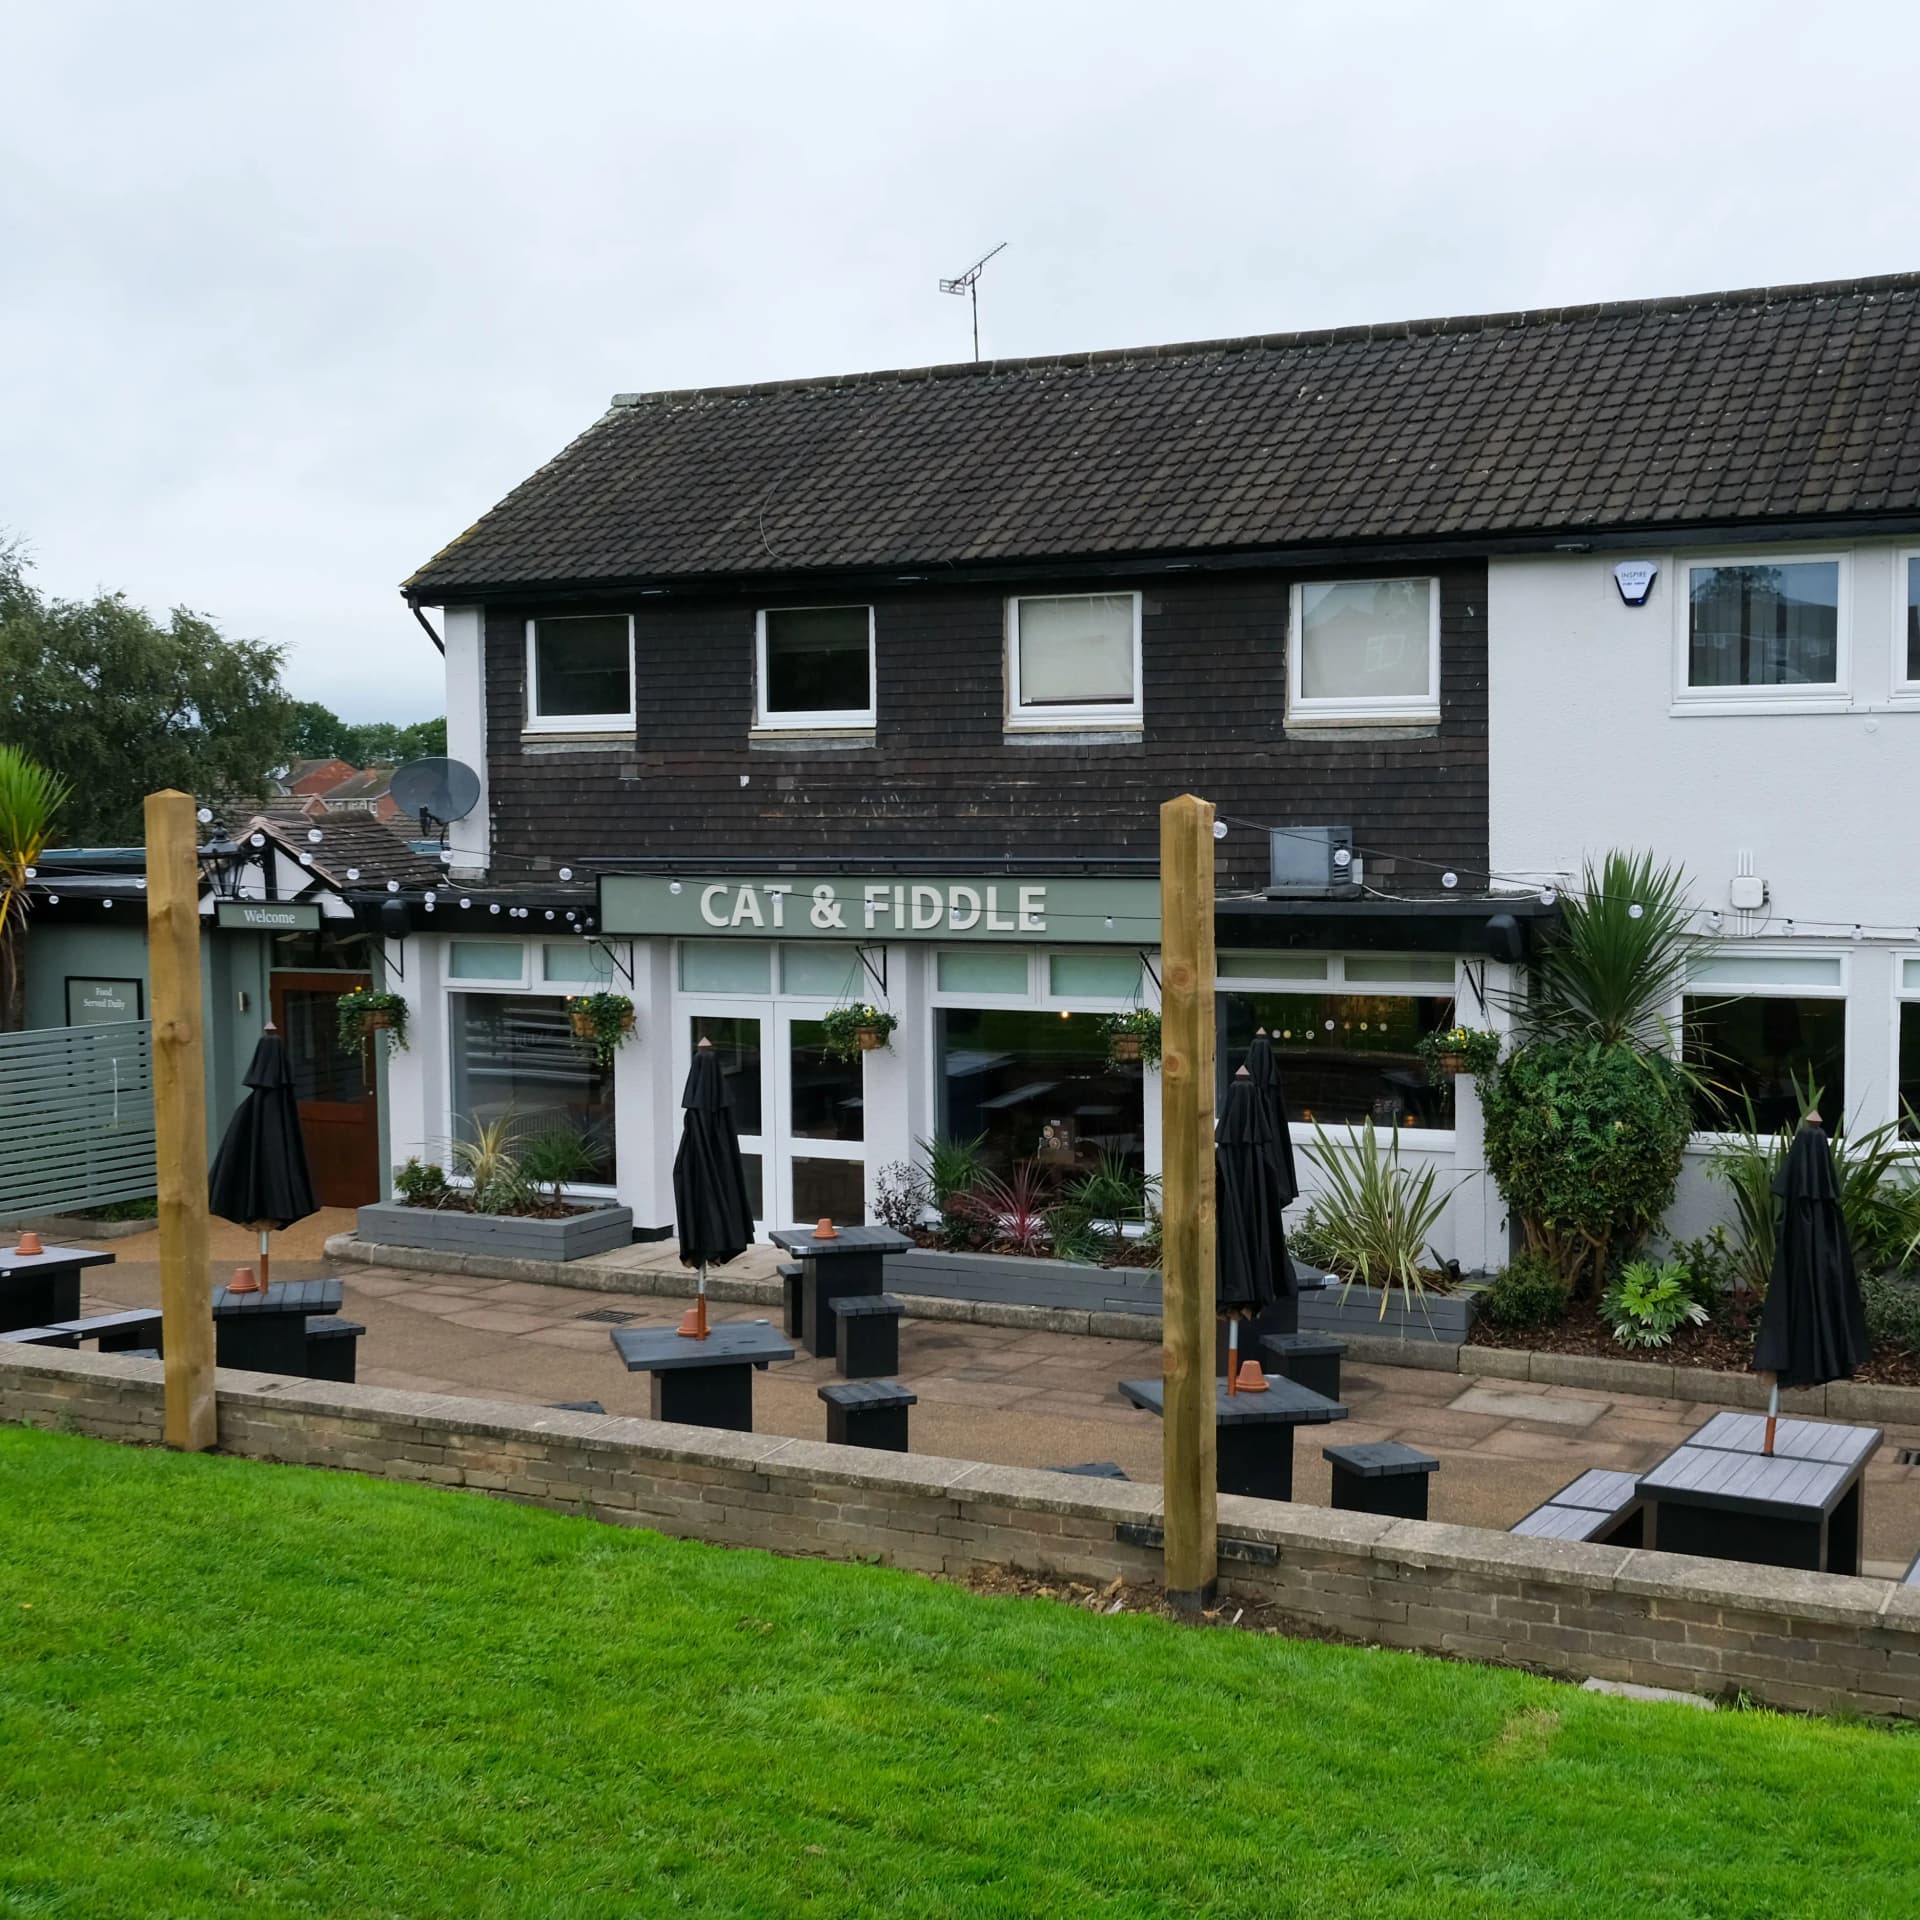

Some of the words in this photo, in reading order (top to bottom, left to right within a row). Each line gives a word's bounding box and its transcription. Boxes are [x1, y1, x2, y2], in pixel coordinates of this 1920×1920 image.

[1621, 571, 1647, 579] INSPIRE
[700, 884, 792, 928] CAT
[810, 884, 847, 930] &
[865, 884, 1047, 932] FIDDLE
[243, 909, 296, 925] Welcome
[95, 987, 113, 997] Food
[83, 998, 107, 1008] Served
[107, 999, 126, 1011] Daily
